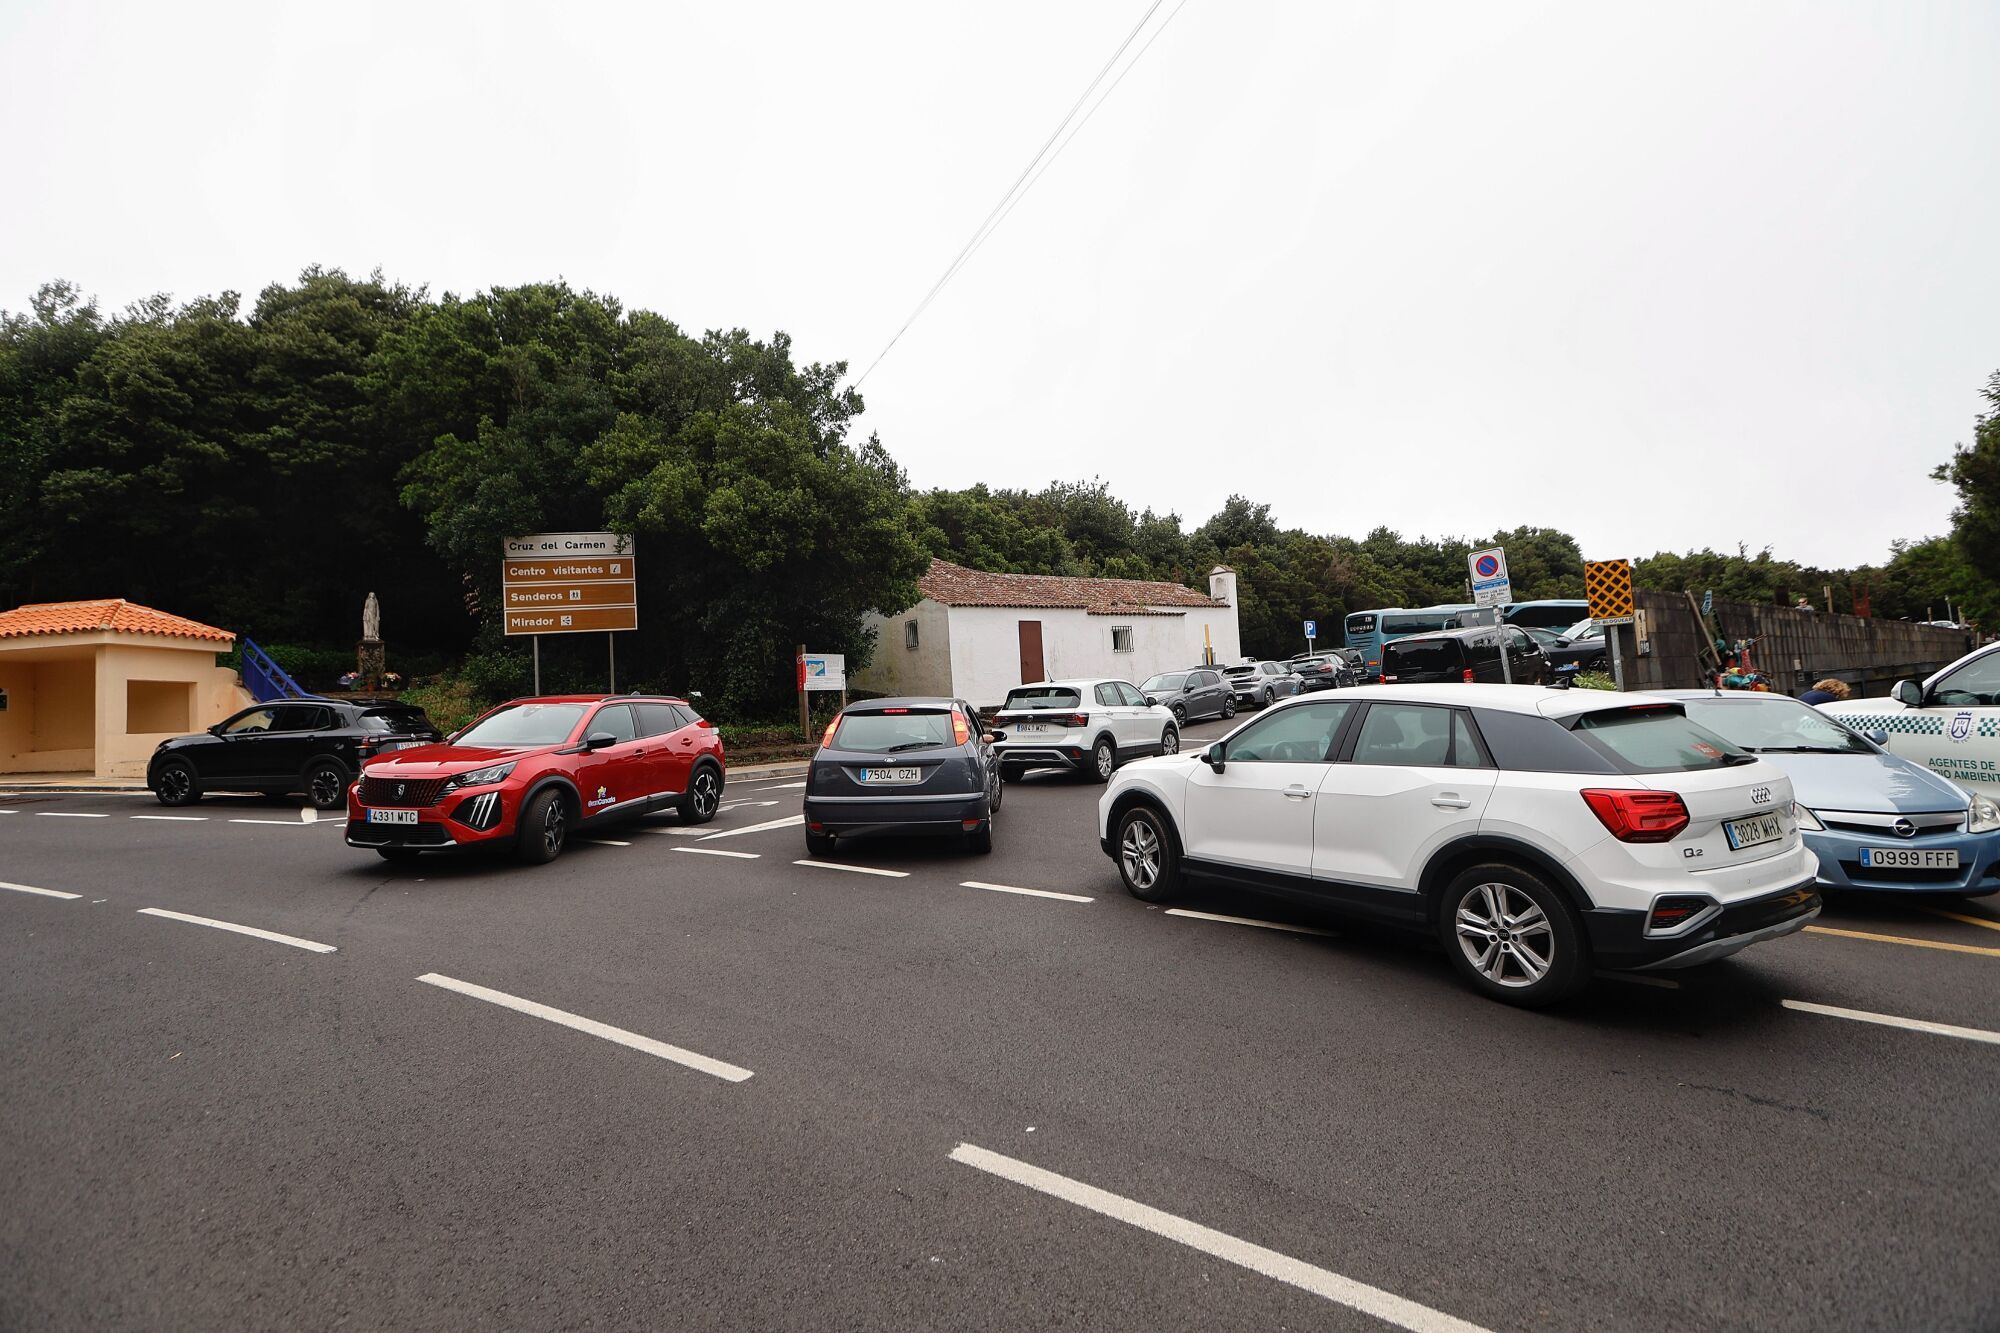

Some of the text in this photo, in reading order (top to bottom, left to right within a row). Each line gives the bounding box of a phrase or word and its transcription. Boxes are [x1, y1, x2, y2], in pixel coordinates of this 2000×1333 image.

[509, 541, 606, 551] Cruz del Carmen
[510, 565, 604, 576] Centro visitantes
[511, 592, 563, 601] Senderos
[511, 618, 554, 627] Mirador
[1307, 623, 1313, 635] P
[1929, 758, 1996, 770] AGENTES DE
[868, 770, 917, 779] 7504 CZH
[373, 811, 416, 822] 4331 MTC
[1735, 822, 1760, 843] 3028
[1760, 817, 1783, 837] MHX
[1683, 847, 1704, 858] Q2
[1874, 851, 1954, 866] 0999 FFF
